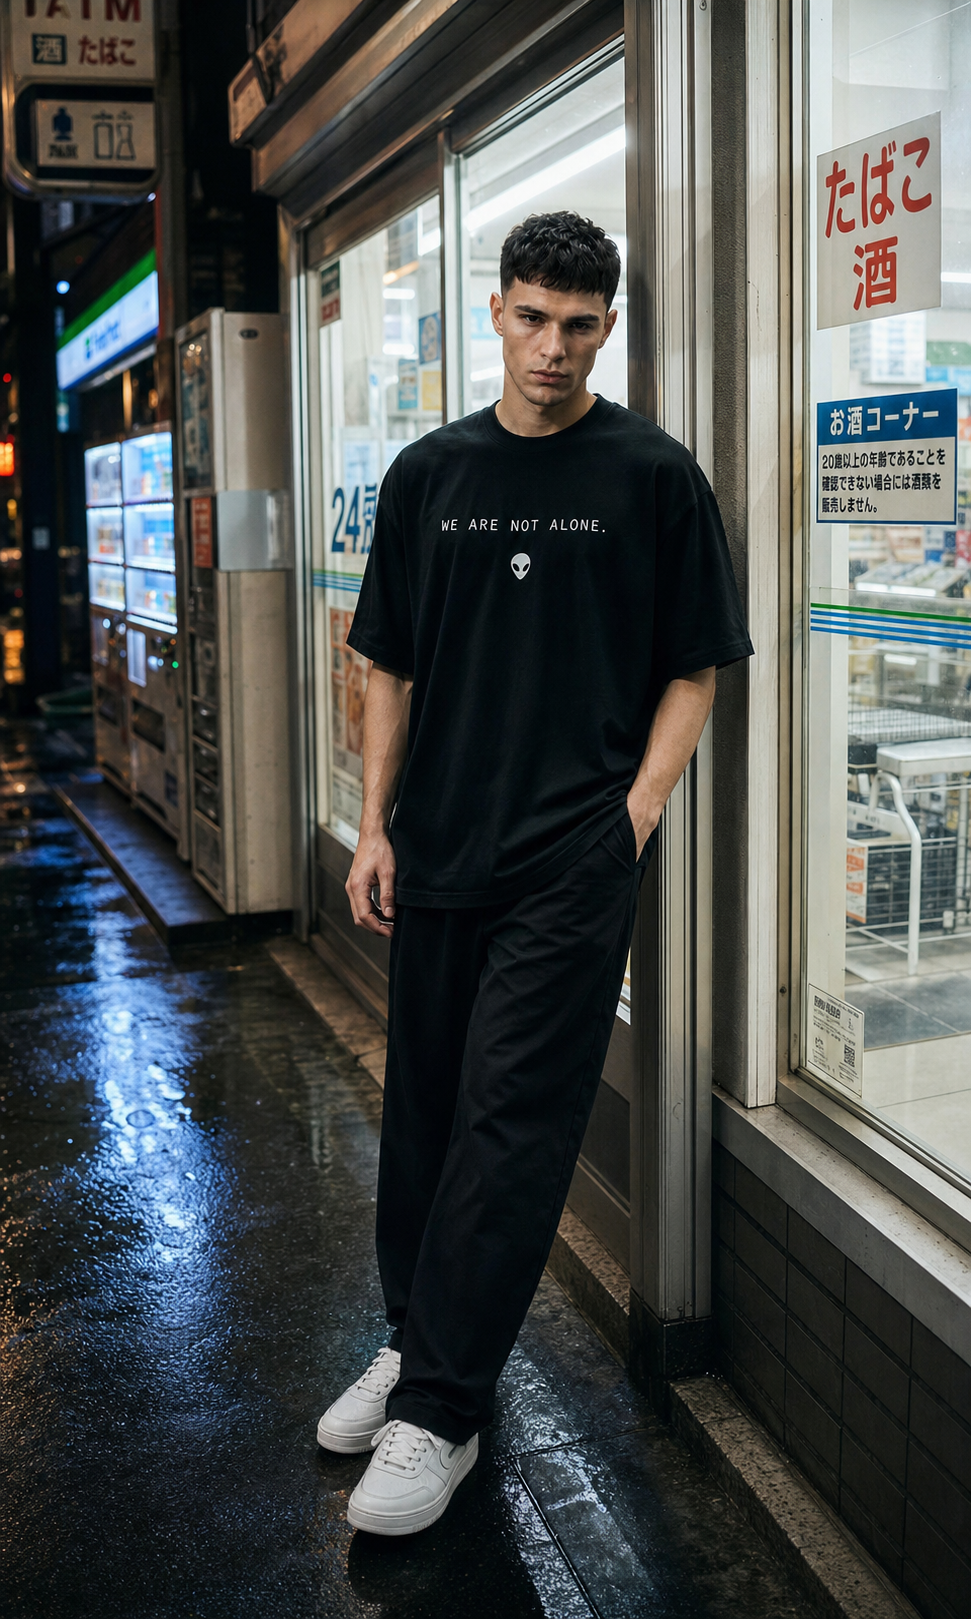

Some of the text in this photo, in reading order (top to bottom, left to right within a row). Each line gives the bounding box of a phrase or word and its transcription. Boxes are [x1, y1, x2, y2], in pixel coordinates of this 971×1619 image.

[79, 35, 136, 65] たばこ
[825, 136, 932, 238] たばこ
[853, 235, 898, 311] 酒
[830, 401, 939, 436] お酒コーナー
[822, 497, 878, 513] 販売しません。
[441, 518, 606, 533] WE ARE NOT ALONE.
